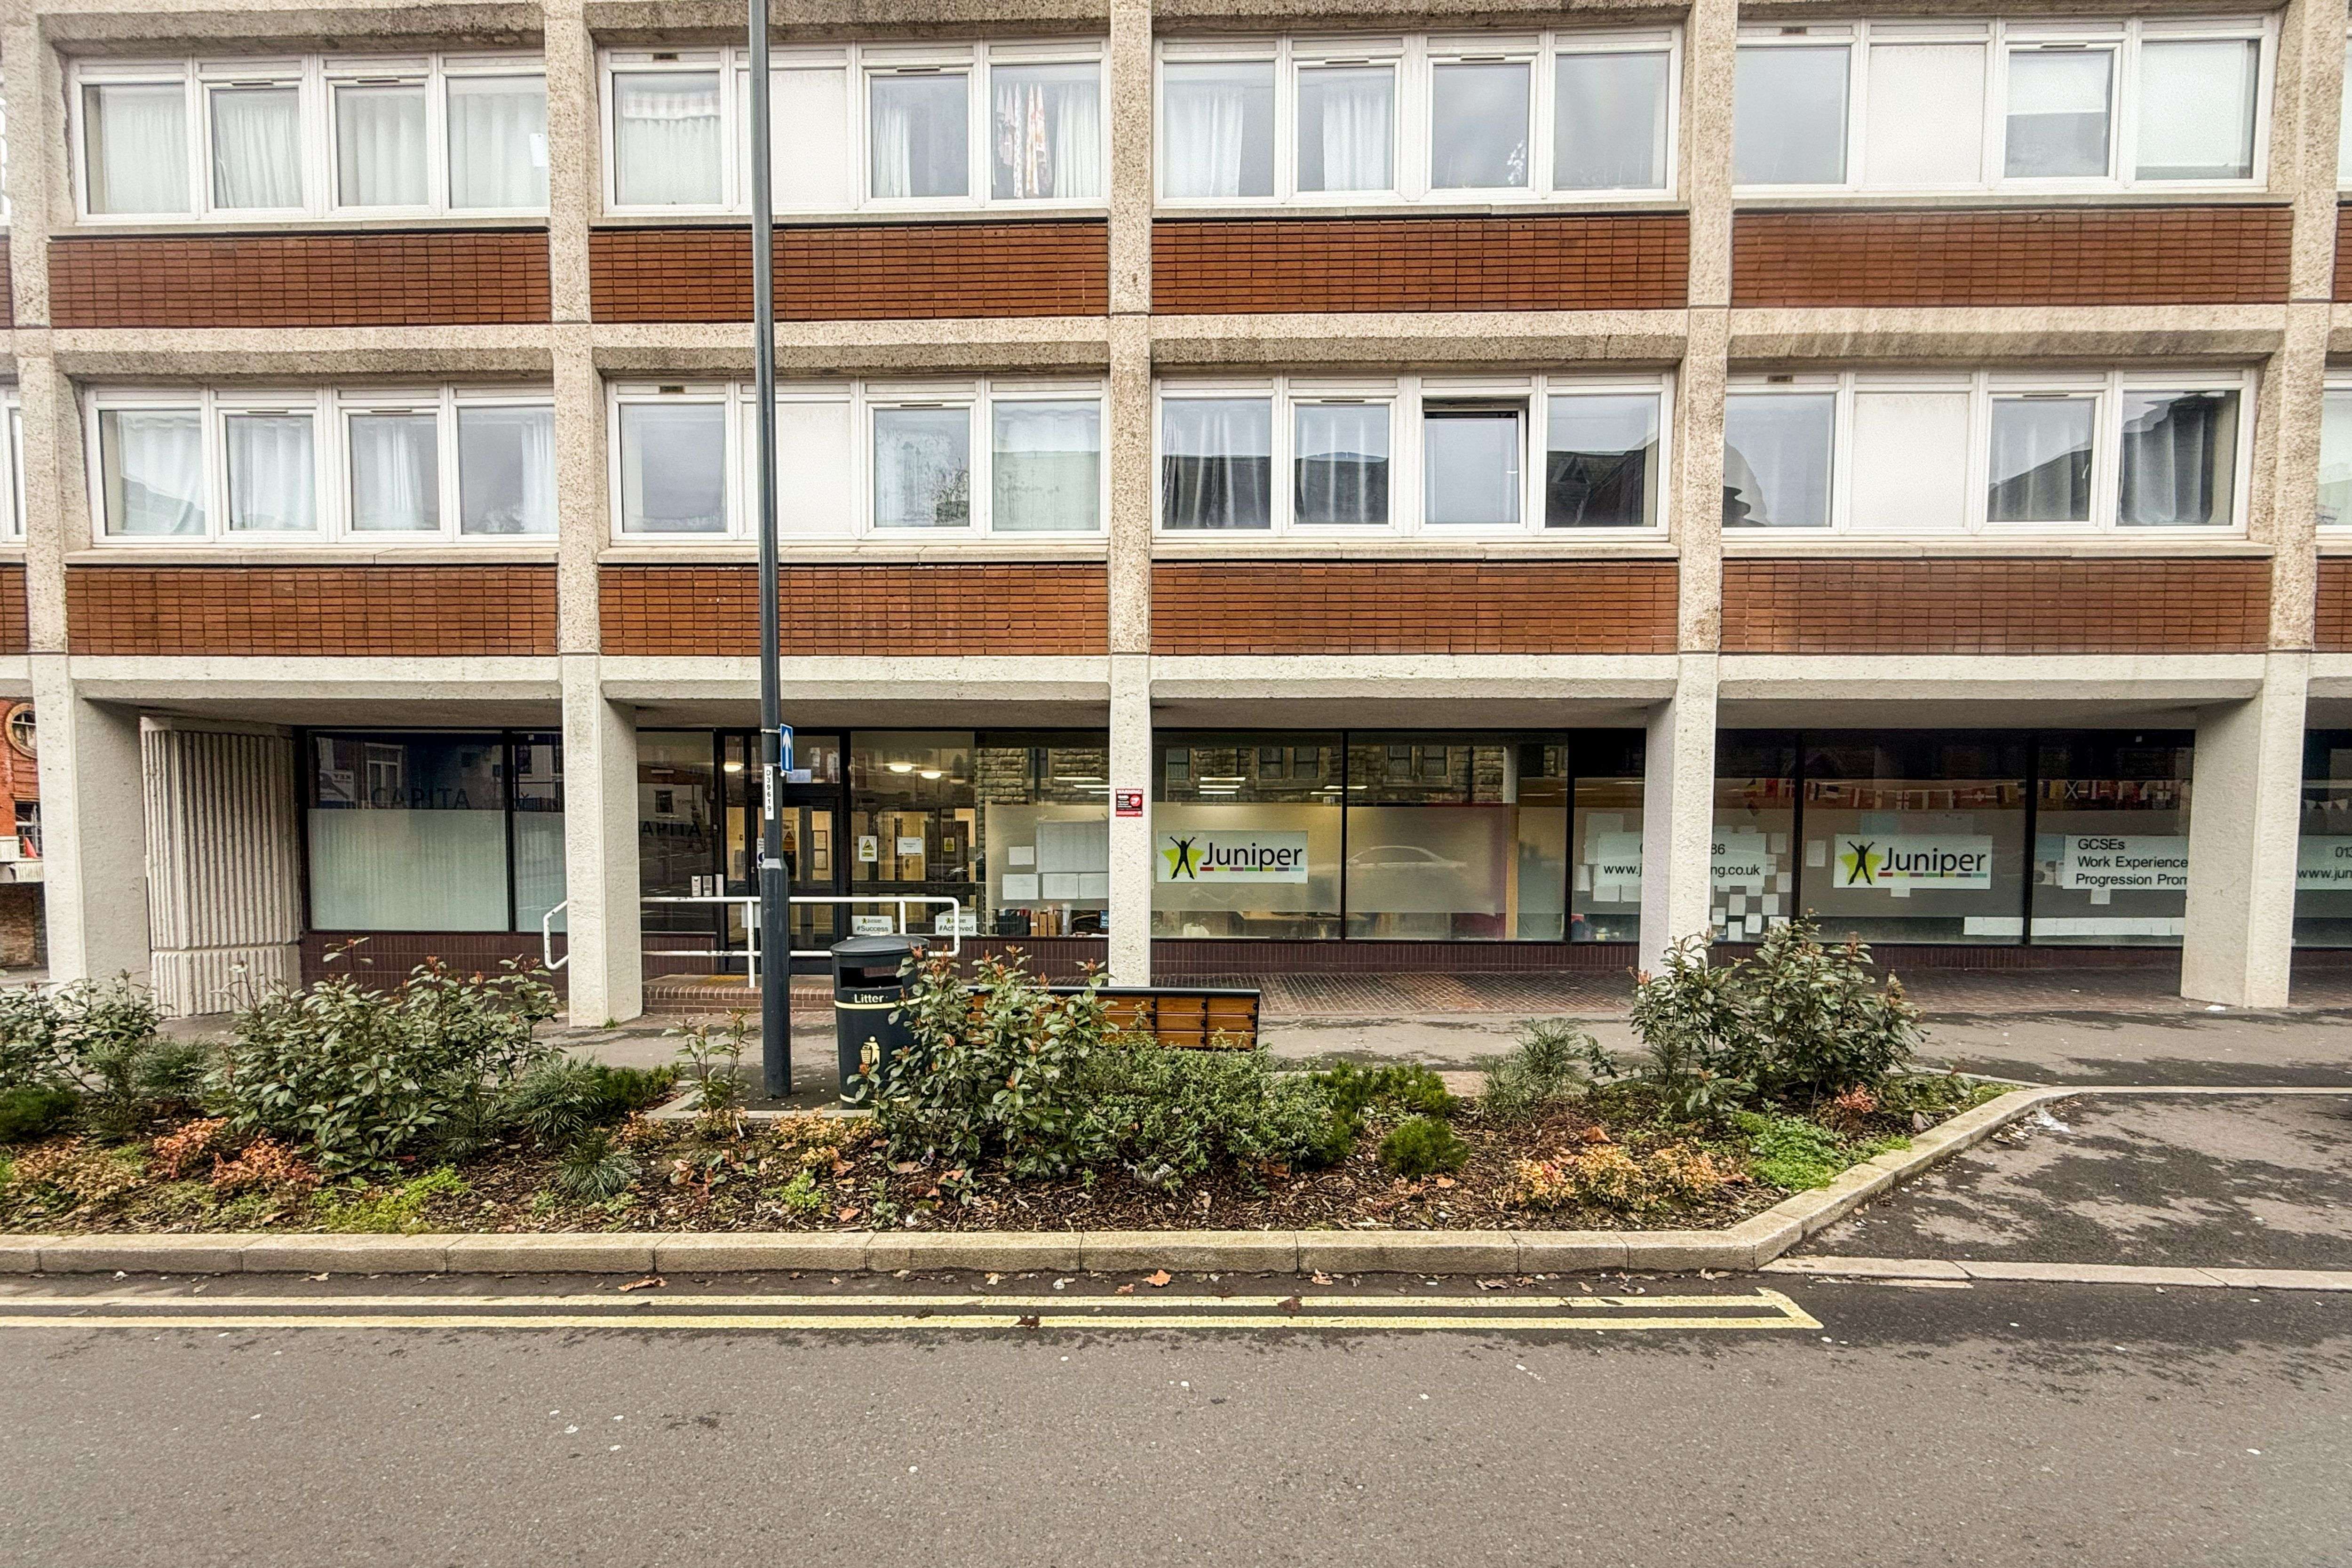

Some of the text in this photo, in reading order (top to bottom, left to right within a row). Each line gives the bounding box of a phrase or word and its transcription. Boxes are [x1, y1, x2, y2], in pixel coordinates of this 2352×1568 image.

[2078, 838, 2125, 850] GCSEs
[1202, 843, 1303, 871] Juniper
[1881, 847, 1986, 877] Juniper
[2078, 856, 2188, 870] Work Experience
[2075, 873, 2152, 887] Progression
[854, 994, 884, 1003] Litter
